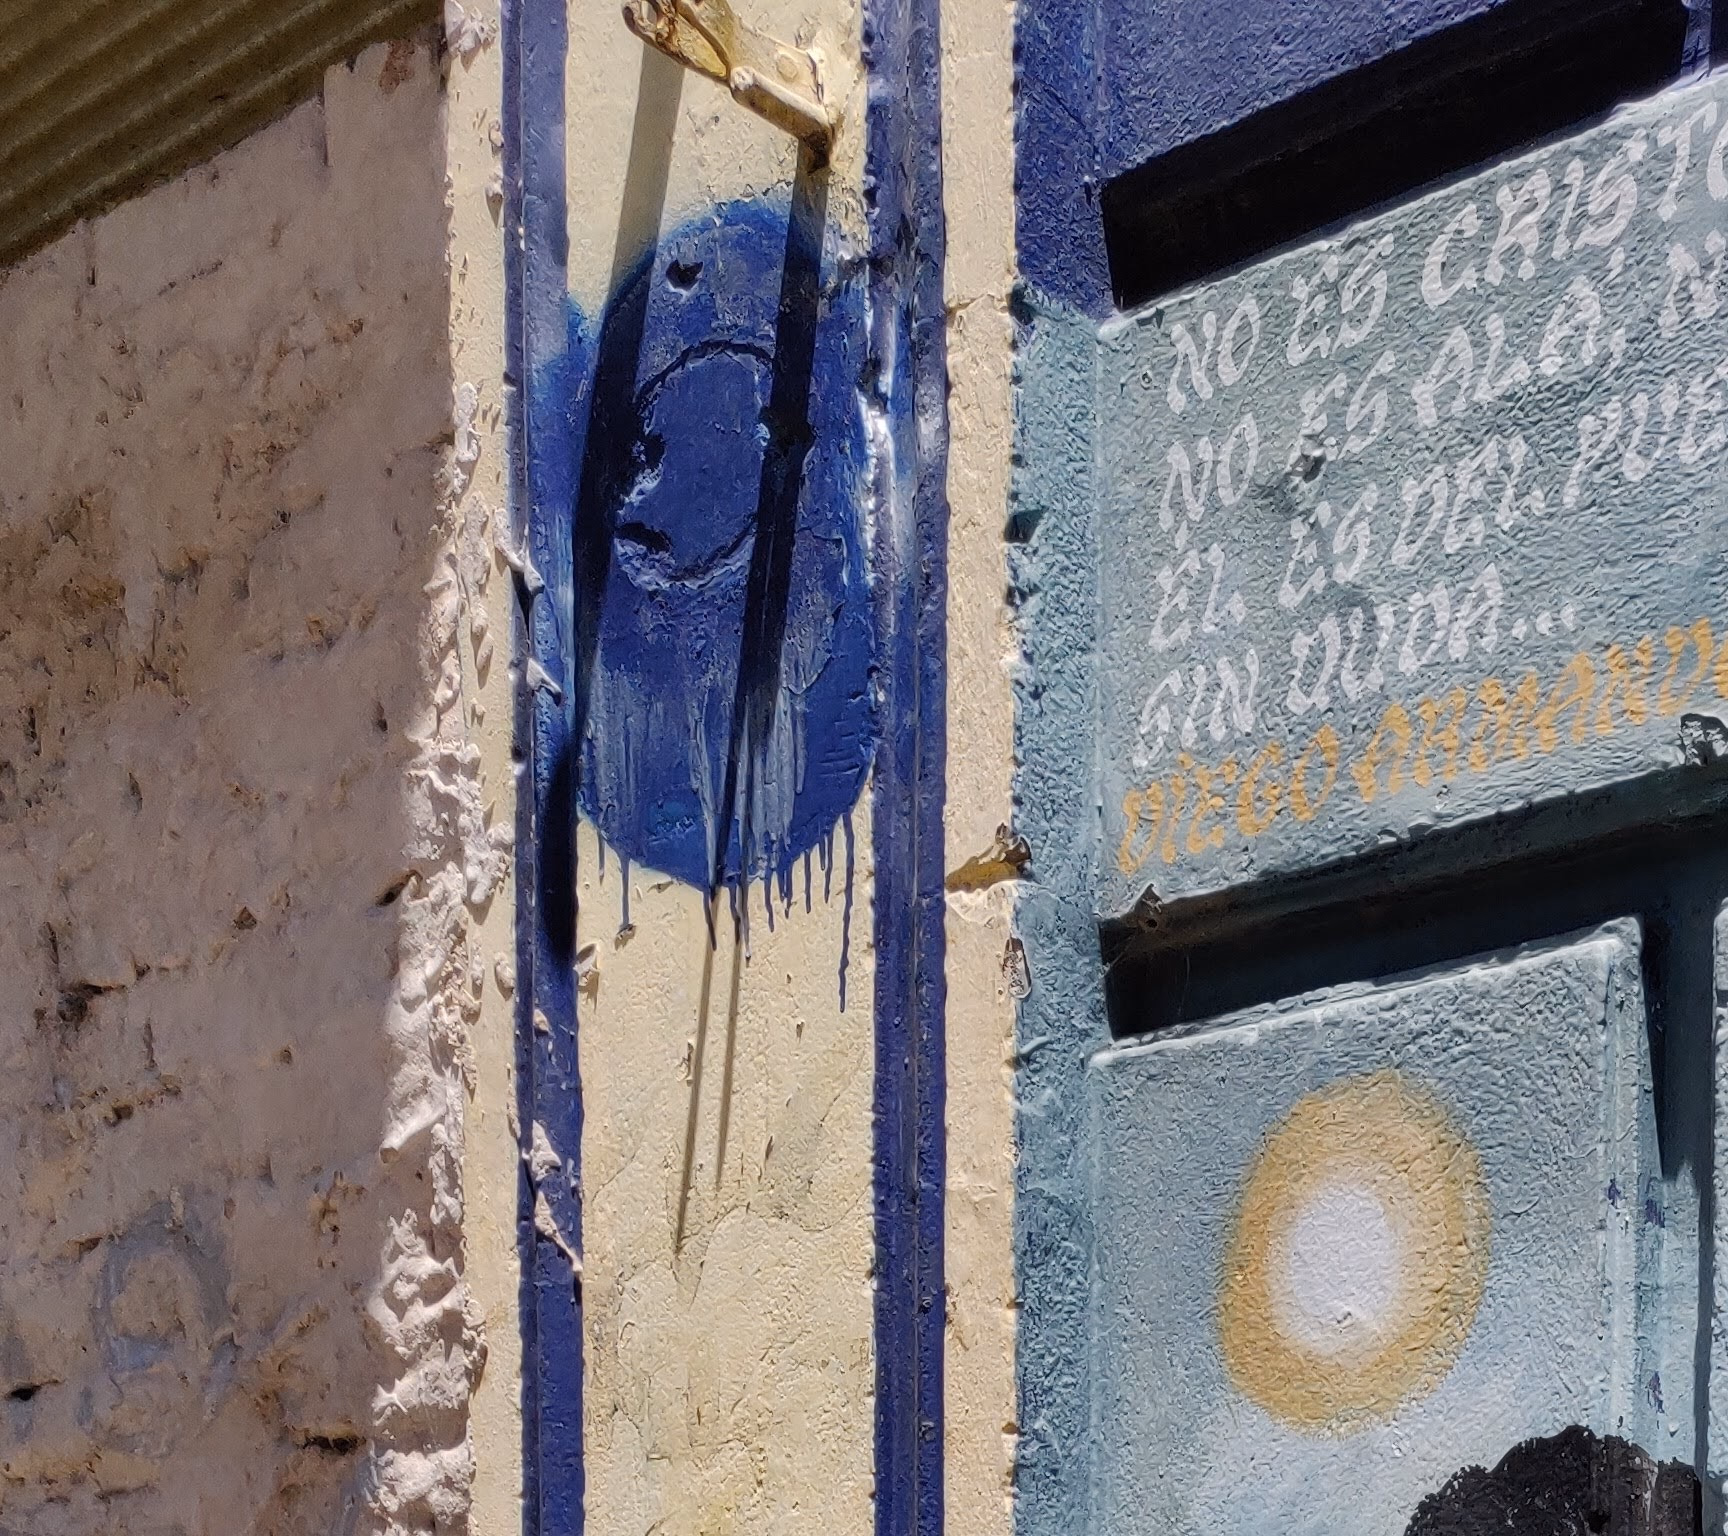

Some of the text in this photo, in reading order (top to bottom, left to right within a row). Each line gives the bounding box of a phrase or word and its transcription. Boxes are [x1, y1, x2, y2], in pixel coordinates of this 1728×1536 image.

[1166, 293, 1262, 415] NO
[1286, 233, 1395, 367] ES
[1156, 411, 1260, 534] NO
[1286, 349, 1397, 479] ES
[1277, 481, 1381, 607] ES
[1391, 432, 1546, 566] DEL
